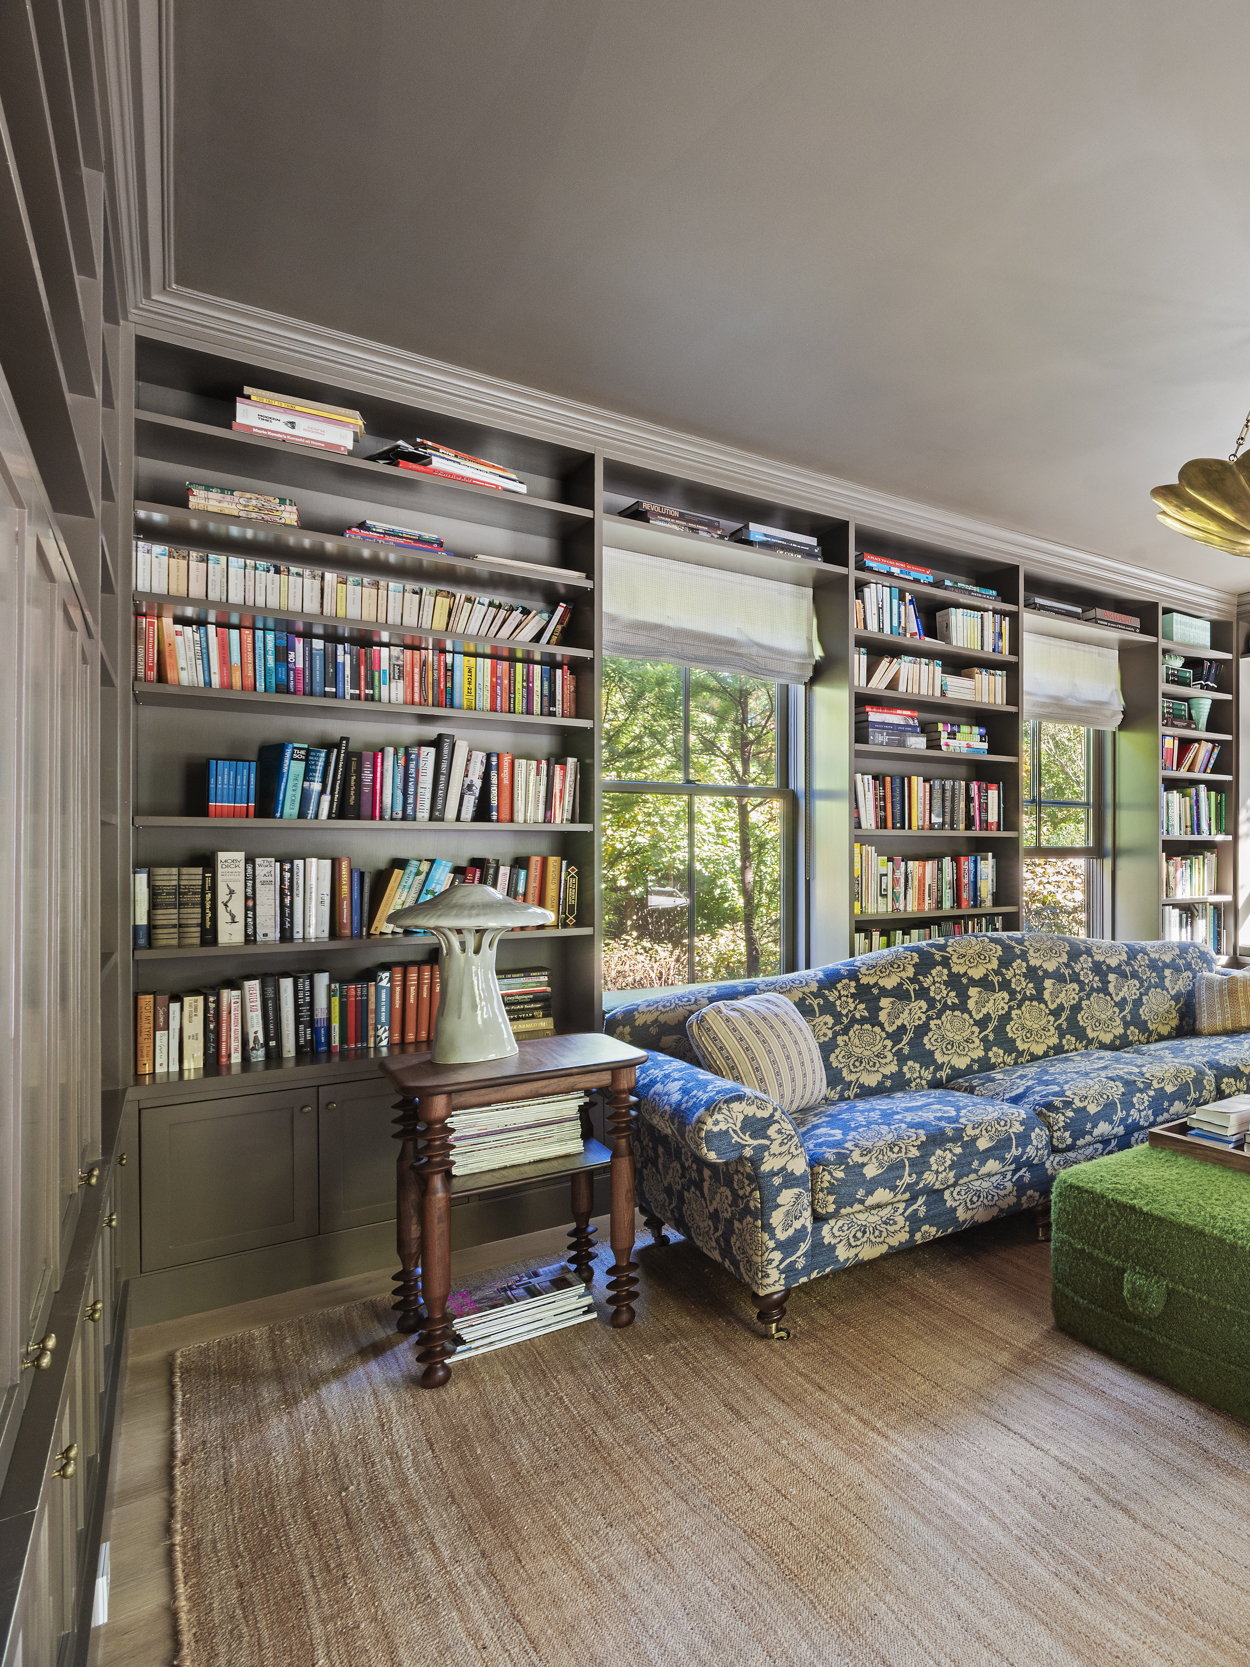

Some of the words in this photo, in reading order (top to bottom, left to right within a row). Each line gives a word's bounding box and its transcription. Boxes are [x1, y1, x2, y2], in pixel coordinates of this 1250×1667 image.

[643, 503, 679, 517] REVOLUTION
[421, 751, 431, 777] Susan
[501, 756, 512, 784] Vonnegut
[248, 983, 257, 1002] THEATER
[250, 1003, 258, 1013] KID
[143, 1025, 151, 1041] TYPE
